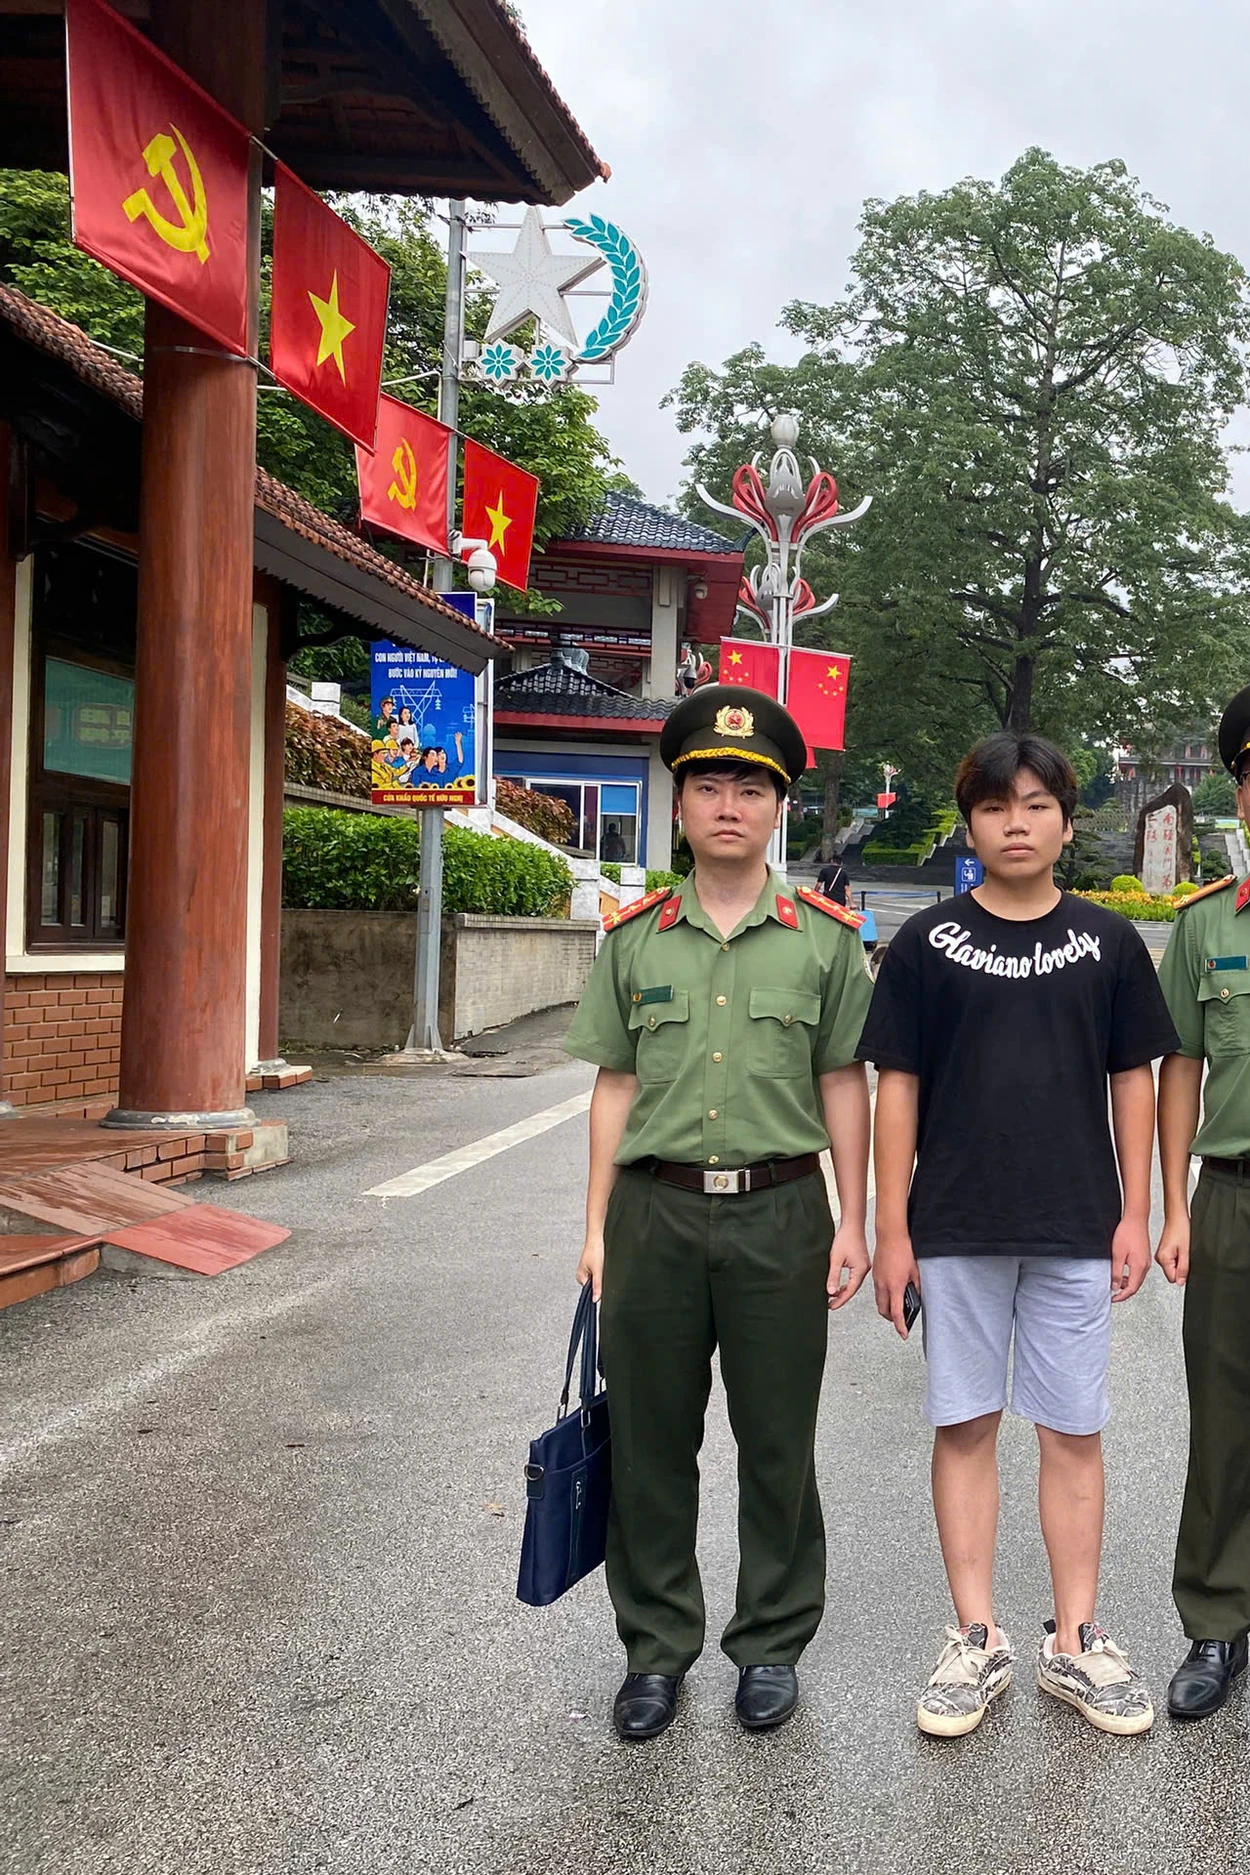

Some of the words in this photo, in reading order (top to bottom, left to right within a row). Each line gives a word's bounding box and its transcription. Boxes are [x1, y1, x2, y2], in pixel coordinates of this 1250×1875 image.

[375, 653, 386, 663] CON
[404, 651, 416, 664] VIỆT
[388, 667, 403, 678] BƯỚC
[423, 667, 444, 678] NGUYÊN
[928, 921, 1033, 979] Glaviano
[1034, 928, 1101, 976] lovely
